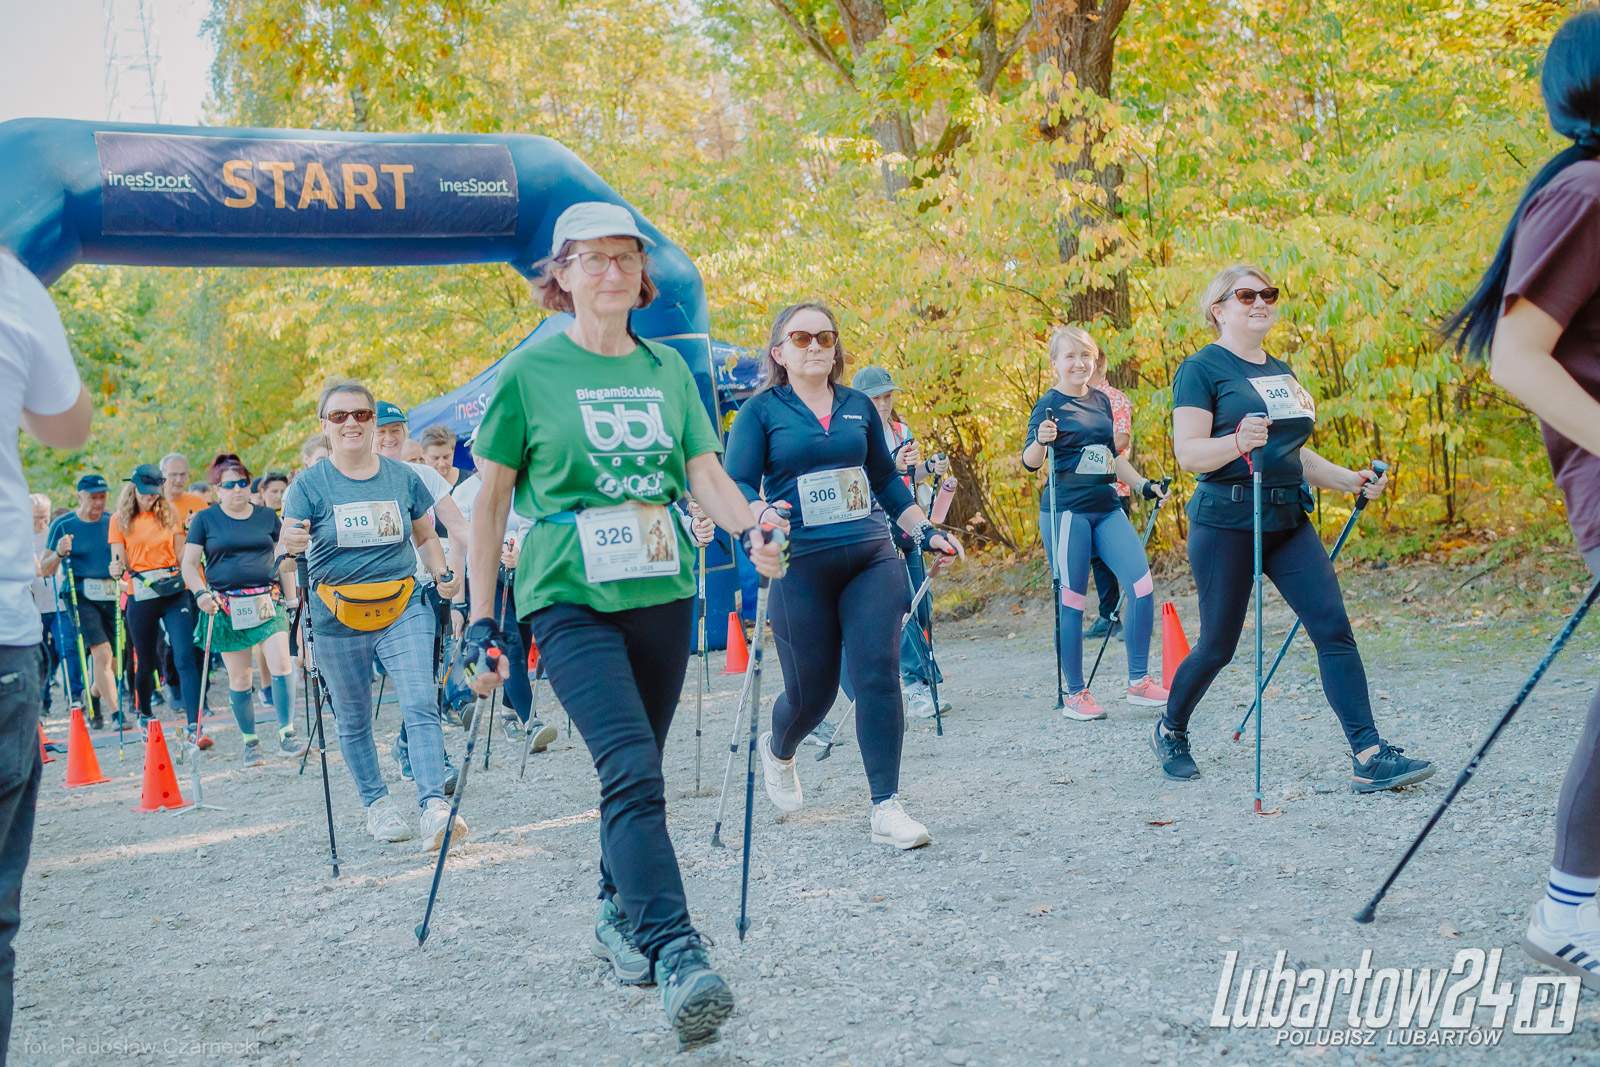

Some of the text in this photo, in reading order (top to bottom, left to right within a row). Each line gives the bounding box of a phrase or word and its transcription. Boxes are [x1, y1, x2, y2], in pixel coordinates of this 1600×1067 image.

[108, 171, 192, 190] inesSport
[223, 160, 415, 210] START
[440, 178, 509, 195] inesSport
[1266, 388, 1289, 399] 349
[1088, 451, 1104, 464] 354
[809, 487, 836, 503] 306
[344, 515, 369, 528] 318
[595, 526, 633, 546] 326
[236, 607, 253, 616] 355
